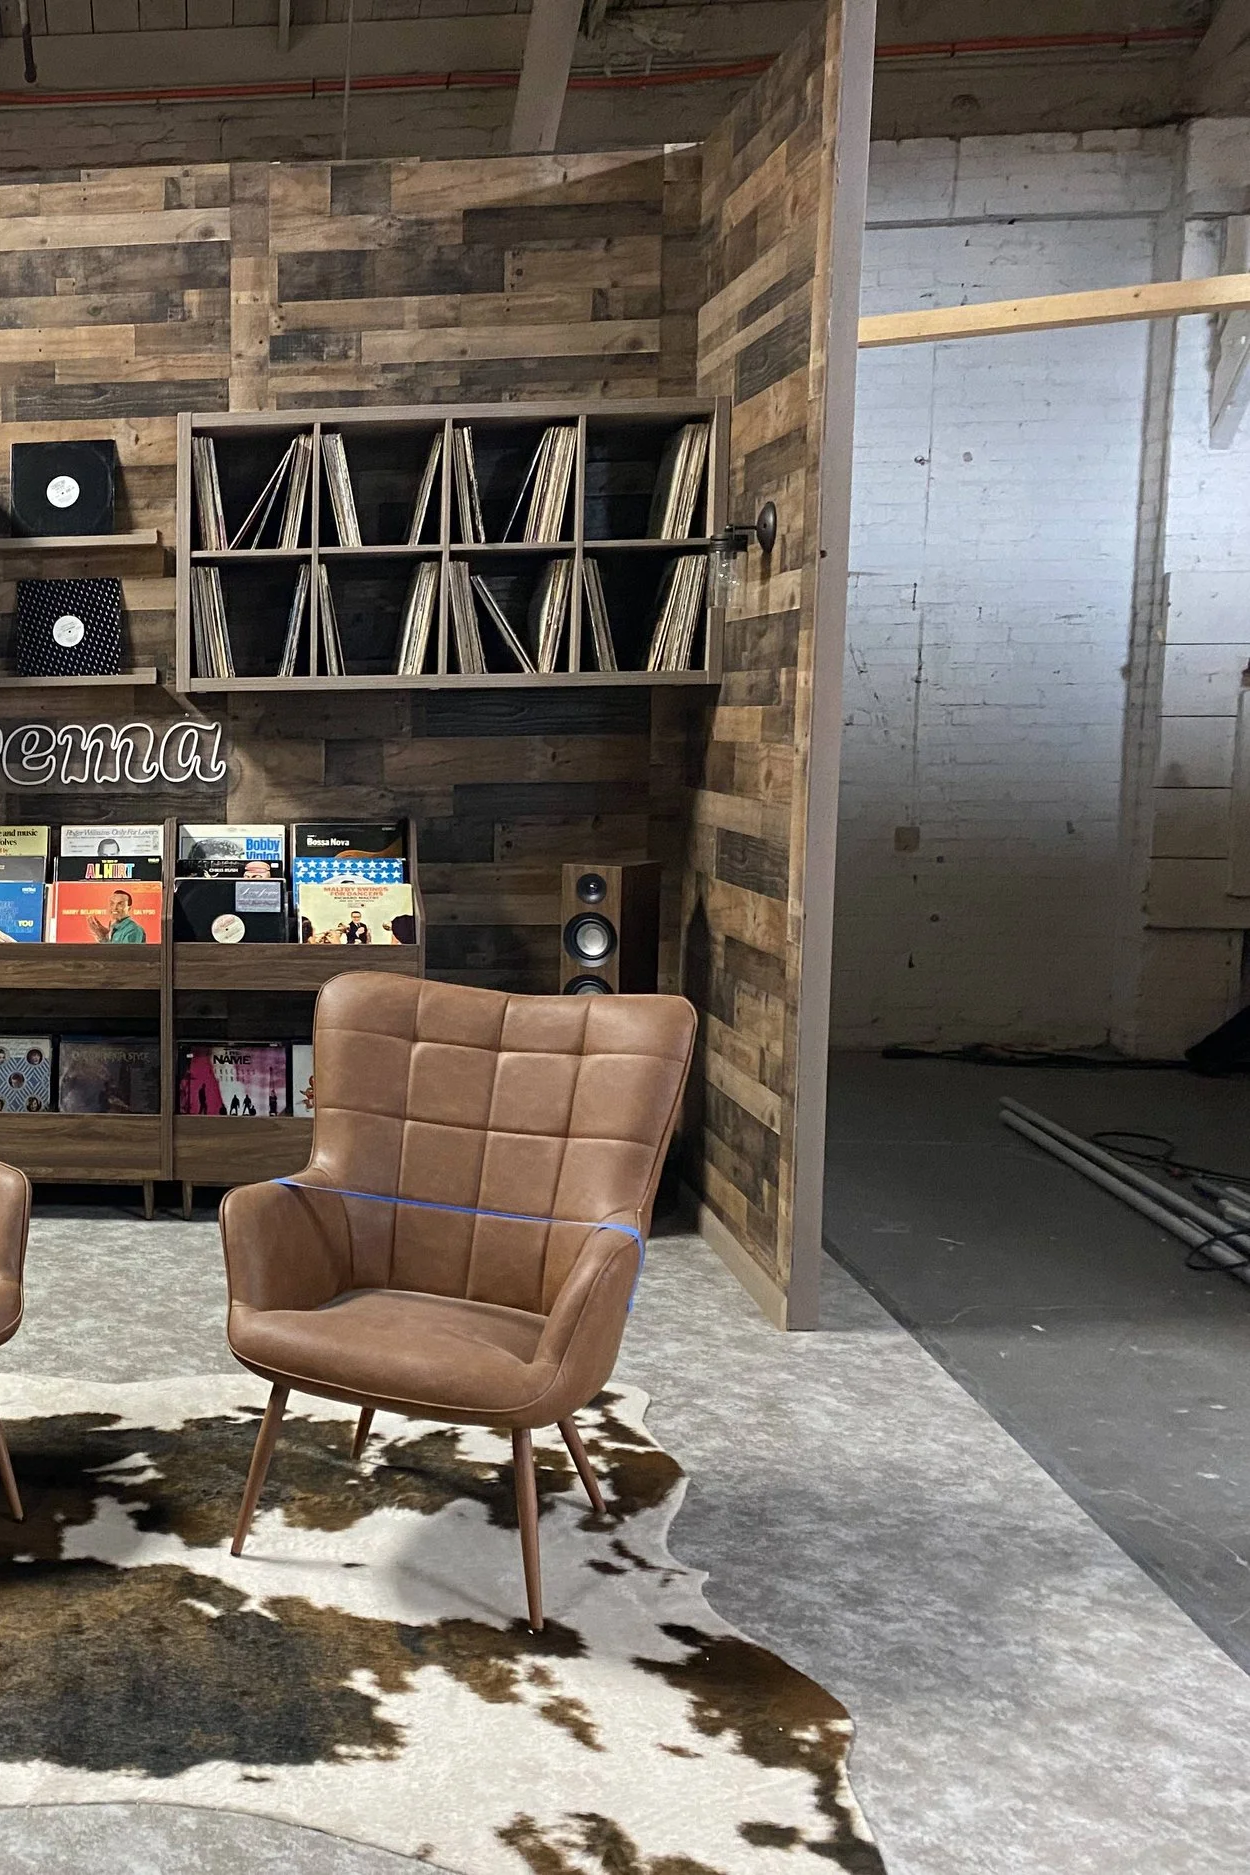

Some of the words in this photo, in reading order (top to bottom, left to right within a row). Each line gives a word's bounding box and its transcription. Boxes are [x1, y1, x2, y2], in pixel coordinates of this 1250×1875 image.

[2, 829, 16, 837] and
[17, 828, 38, 836] music
[245, 838, 281, 851] Bobby
[306, 837, 330, 846] Bossa
[330, 838, 350, 846] Nova
[85, 863, 103, 879] AL
[103, 863, 136, 879] HIRT
[213, 1054, 251, 1065] NAME
